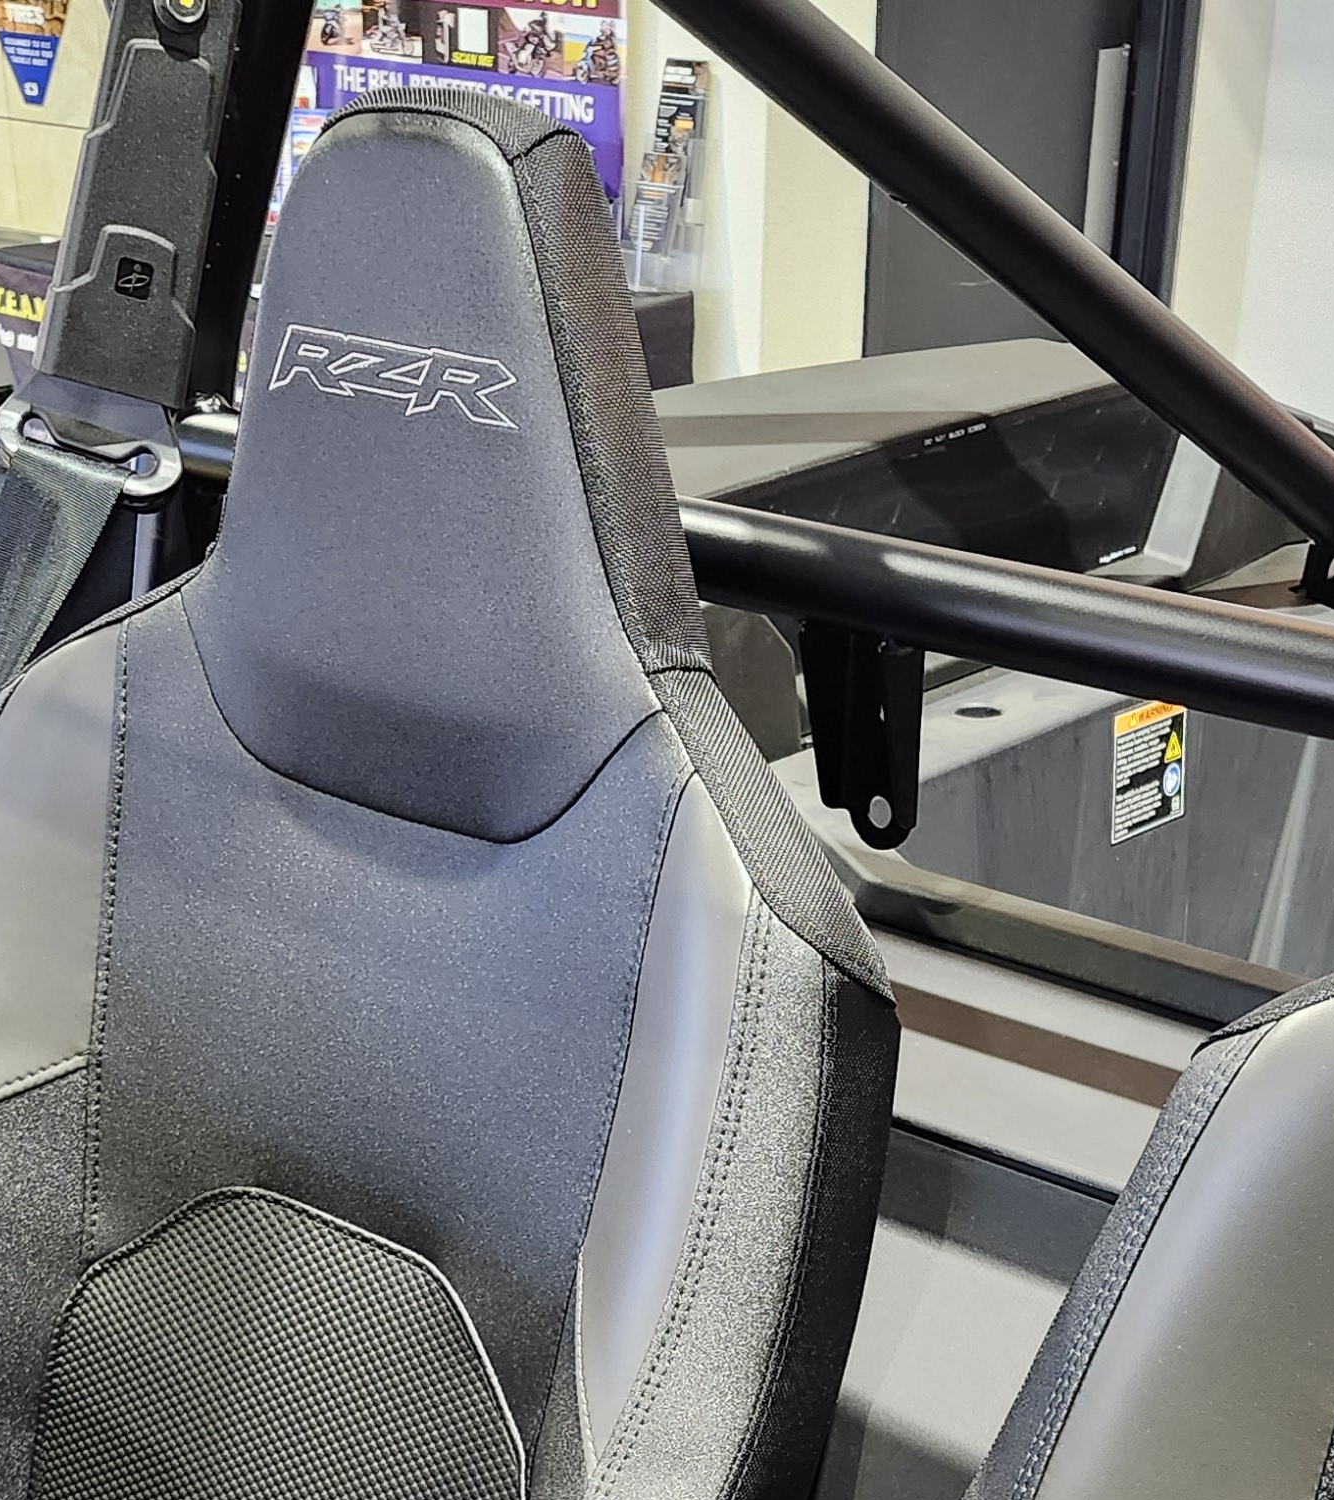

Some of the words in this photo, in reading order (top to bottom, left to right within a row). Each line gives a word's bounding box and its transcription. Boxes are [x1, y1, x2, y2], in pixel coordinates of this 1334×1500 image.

[452, 51, 478, 66] SCAN
[478, 54, 496, 68] ME
[333, 64, 366, 92] THE
[367, 68, 403, 91] REAL
[488, 84, 514, 100] OF
[516, 87, 595, 124] GETTING
